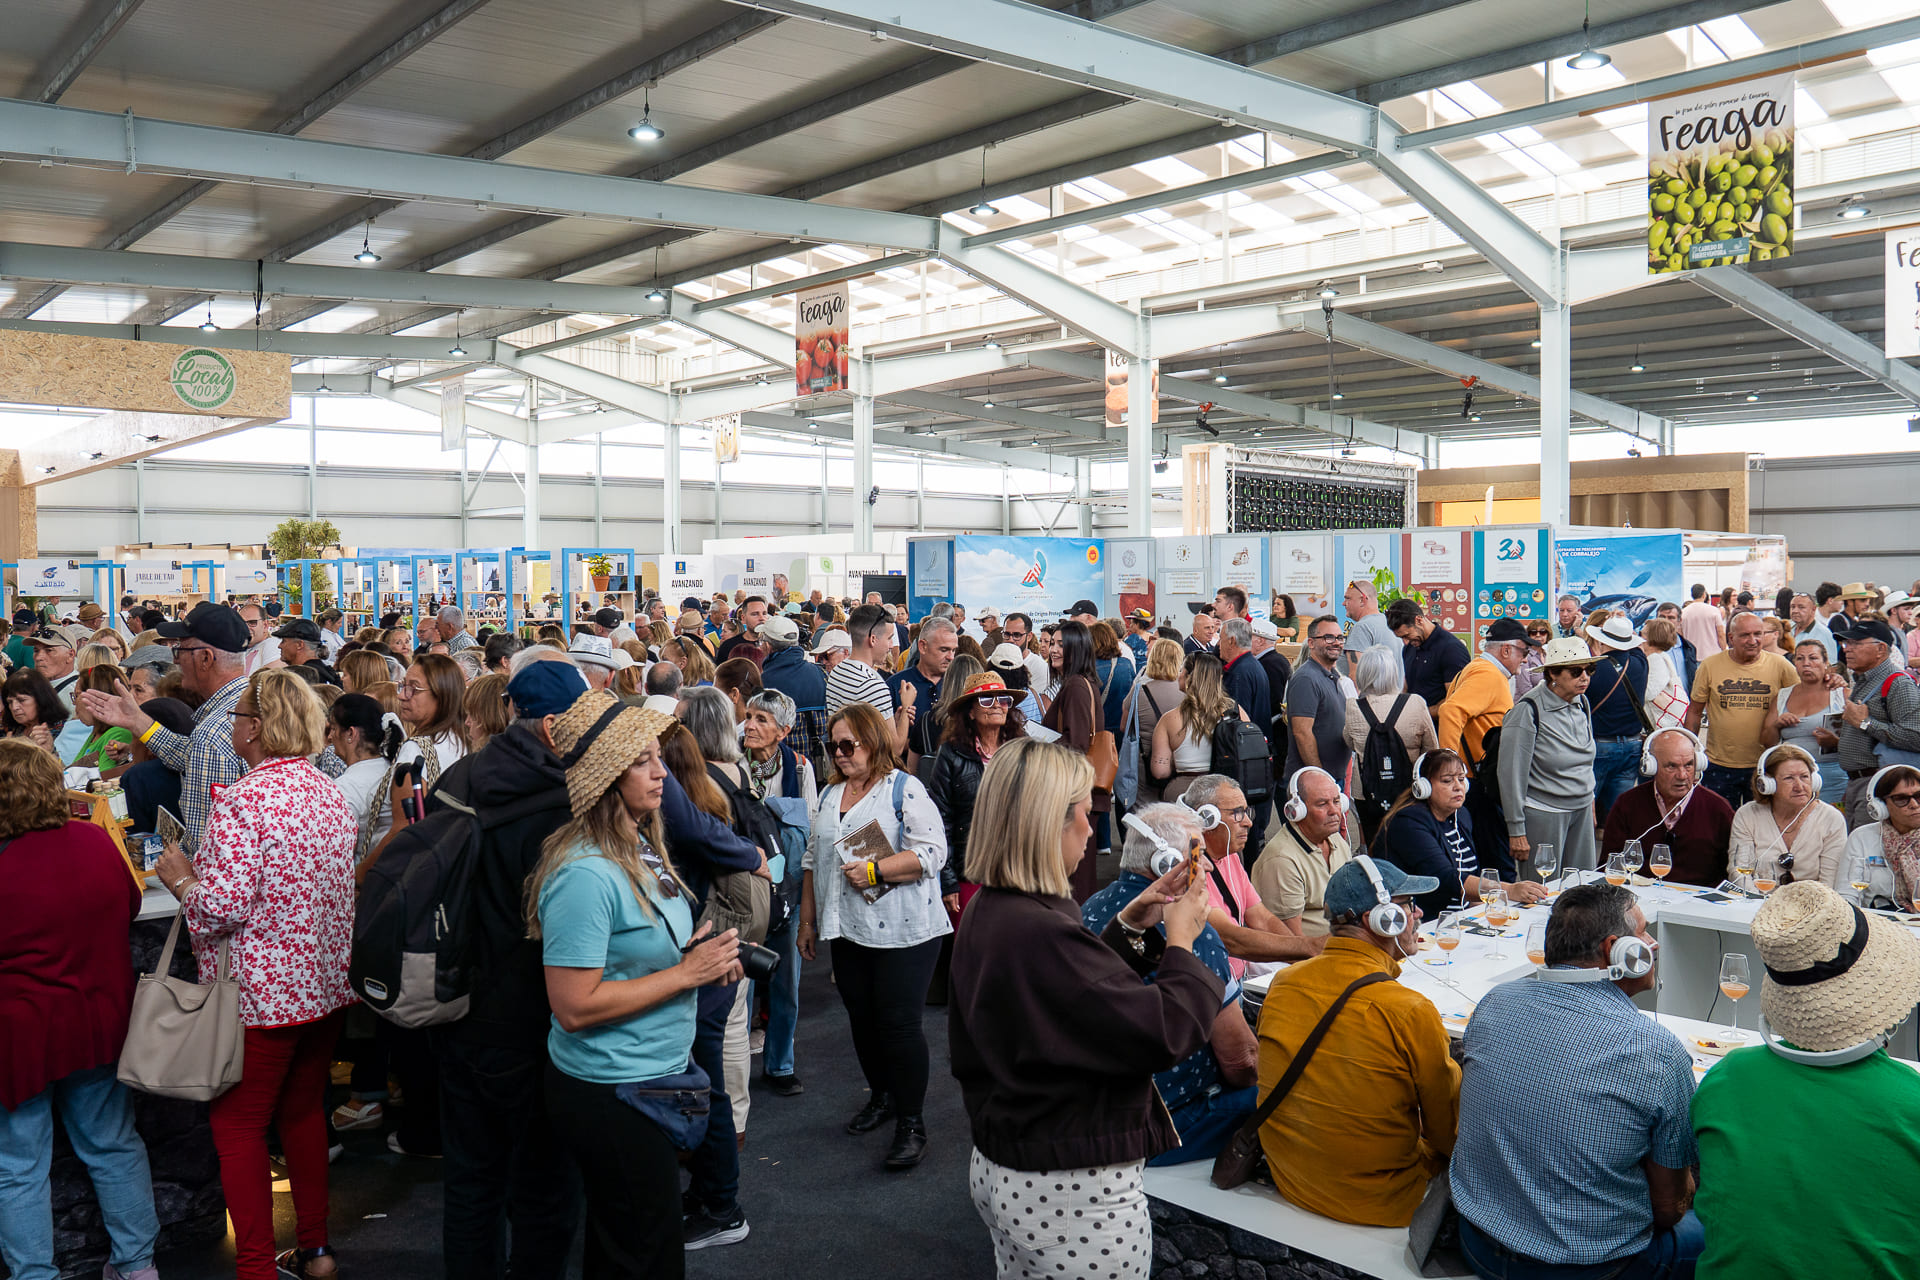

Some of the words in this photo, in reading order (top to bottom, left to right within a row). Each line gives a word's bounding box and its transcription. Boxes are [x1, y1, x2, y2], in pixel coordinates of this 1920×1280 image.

[1660, 99, 1787, 151] Feaga
[800, 296, 845, 326] Feaga
[191, 349, 219, 359] CONSUME
[172, 359, 231, 385] Local
[196, 363, 223, 371] PRODUCTO
[192, 385, 221, 397] 100%
[671, 579, 704, 588] AVANZANDO
[743, 577, 767, 587] AVANZANDO
